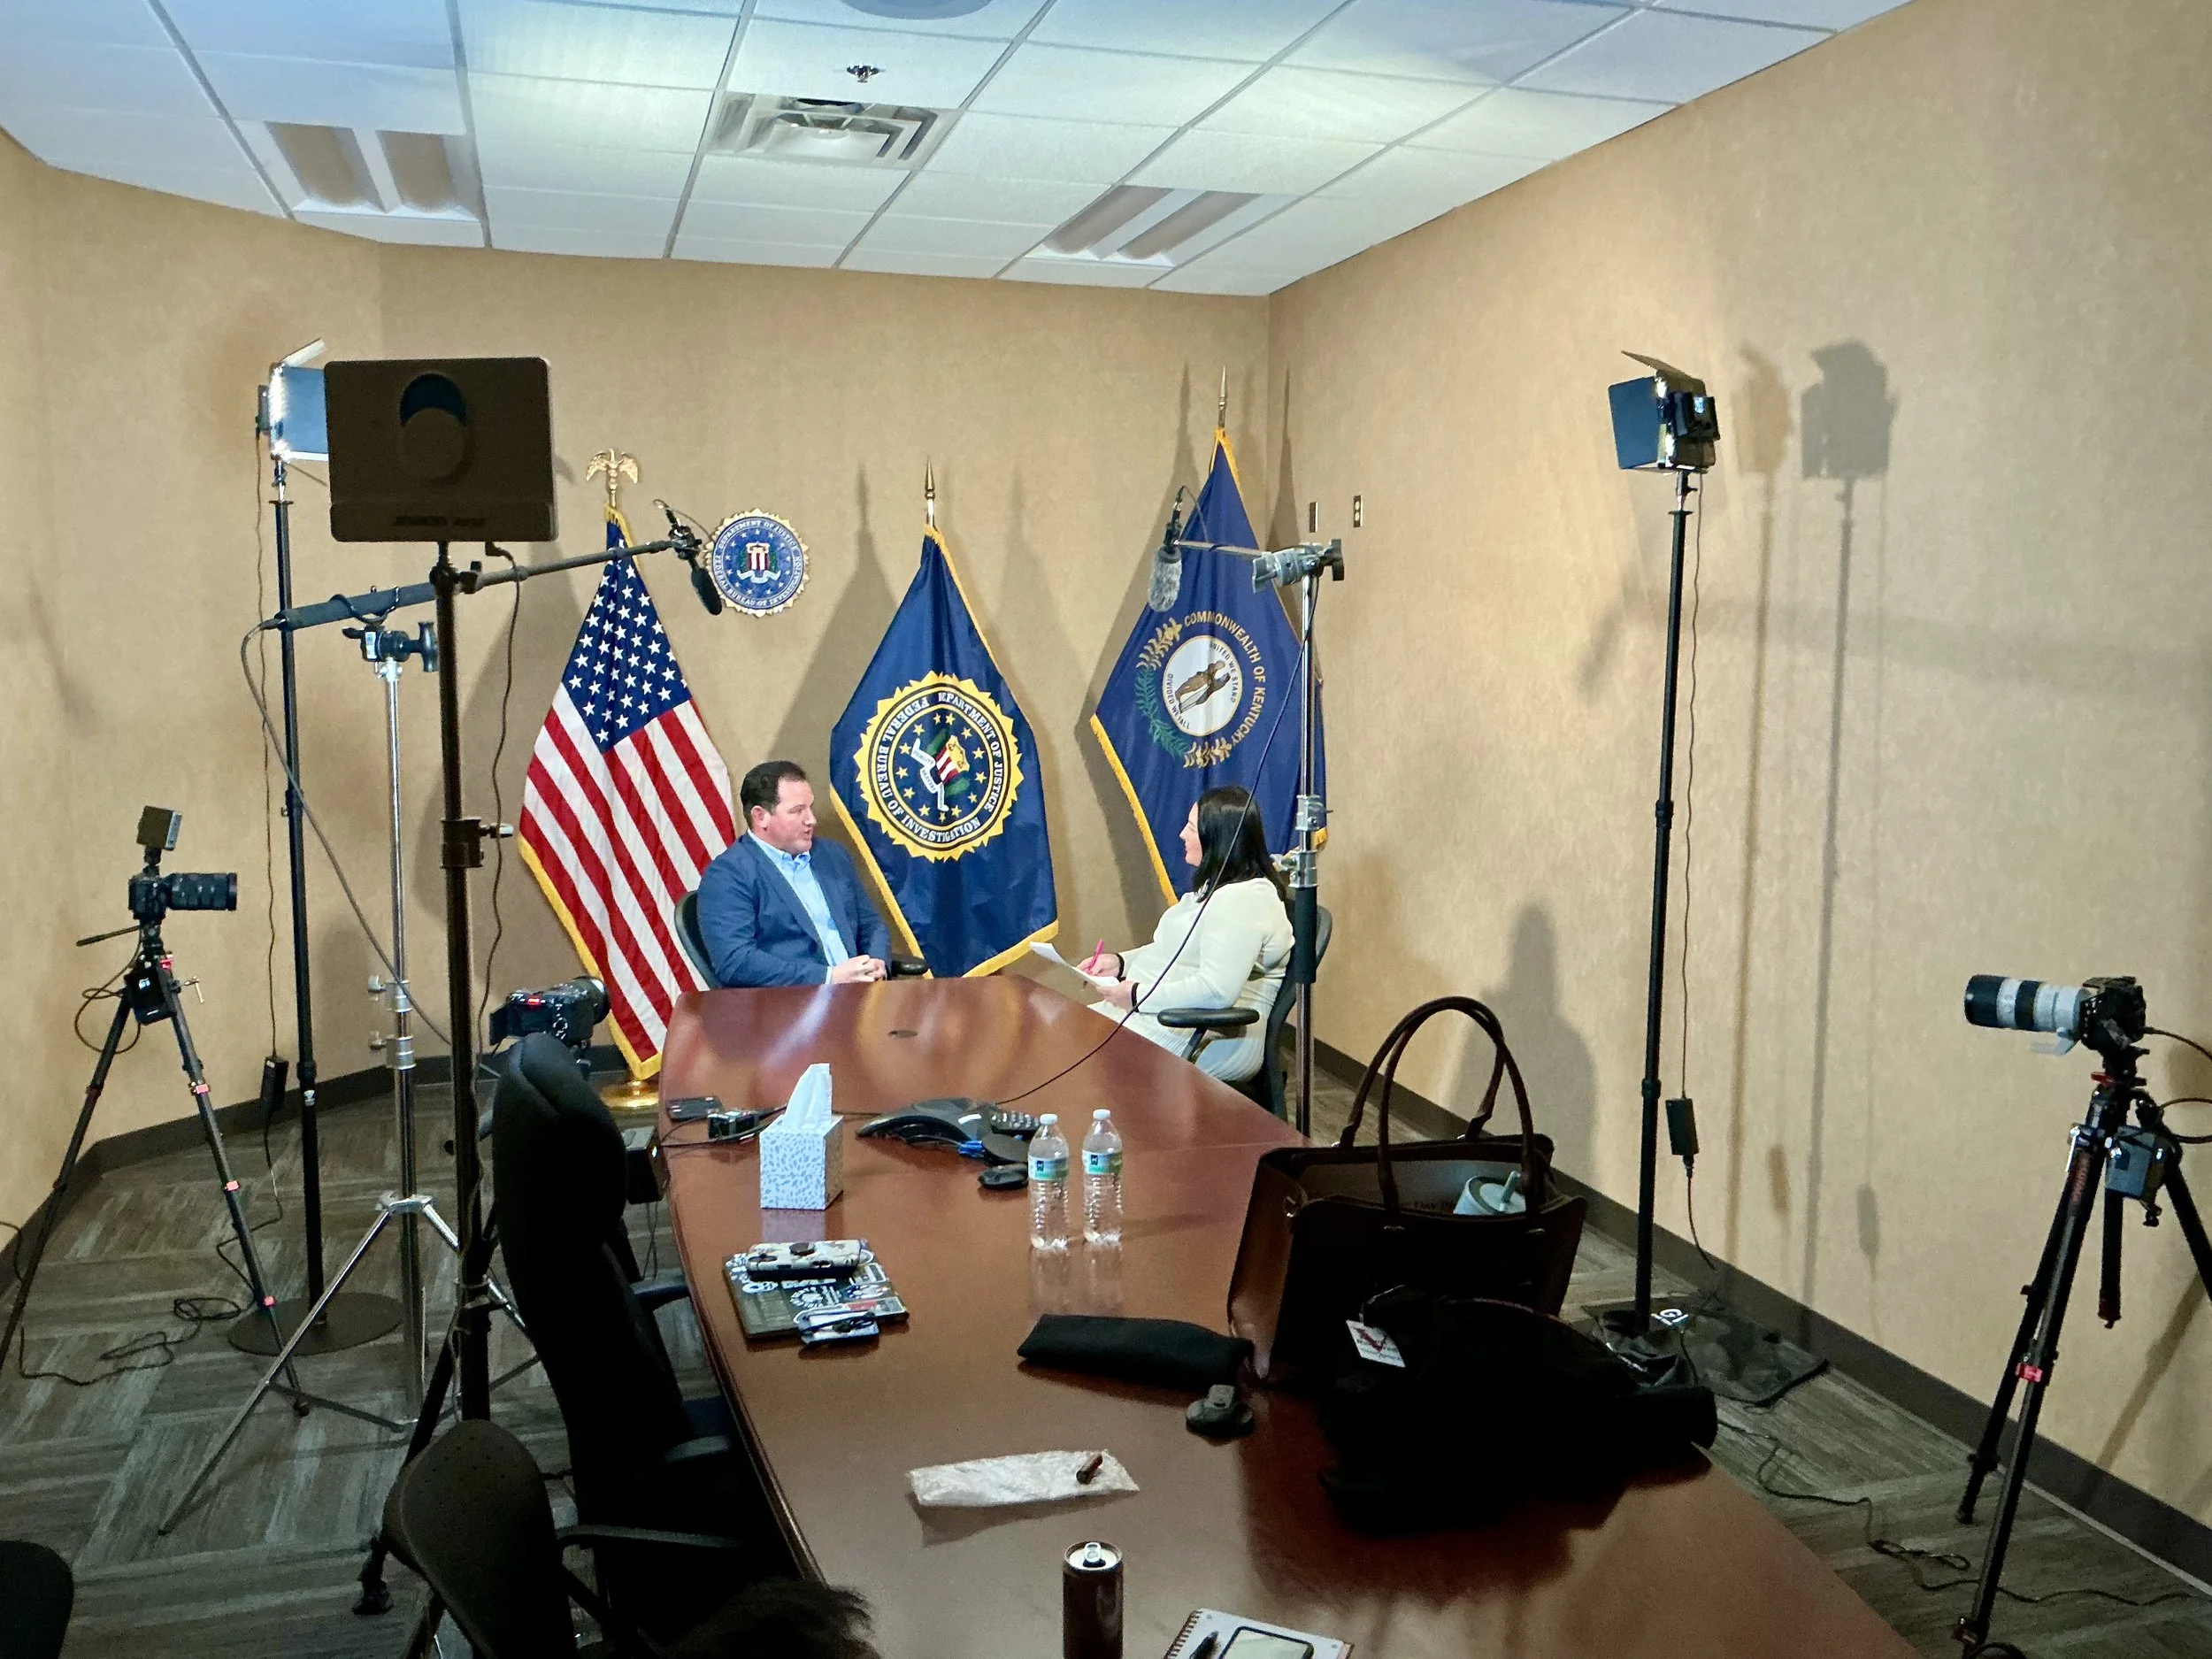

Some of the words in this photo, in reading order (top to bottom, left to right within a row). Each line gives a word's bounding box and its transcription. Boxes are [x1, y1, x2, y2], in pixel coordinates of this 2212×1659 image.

[727, 588, 755, 605] BUREAU
[1184, 611, 1262, 664] COMMONWEALTH
[1210, 642, 1231, 661] UNITED
[1228, 661, 1237, 672] WE
[1253, 664, 1265, 682] OF
[882, 696, 930, 741] FEDERAL
[1166, 673, 1175, 705] DIVIDED
[1171, 704, 1180, 718] WE
[1178, 715, 1191, 730] FALL
[1231, 687, 1266, 746] KENTUCKY
[990, 741, 1002, 757] OF
[876, 747, 893, 798] BUREAU
[984, 761, 1004, 813] JUSTICE
[887, 800, 904, 816] OF
[901, 816, 981, 843] INVESTIGATION
